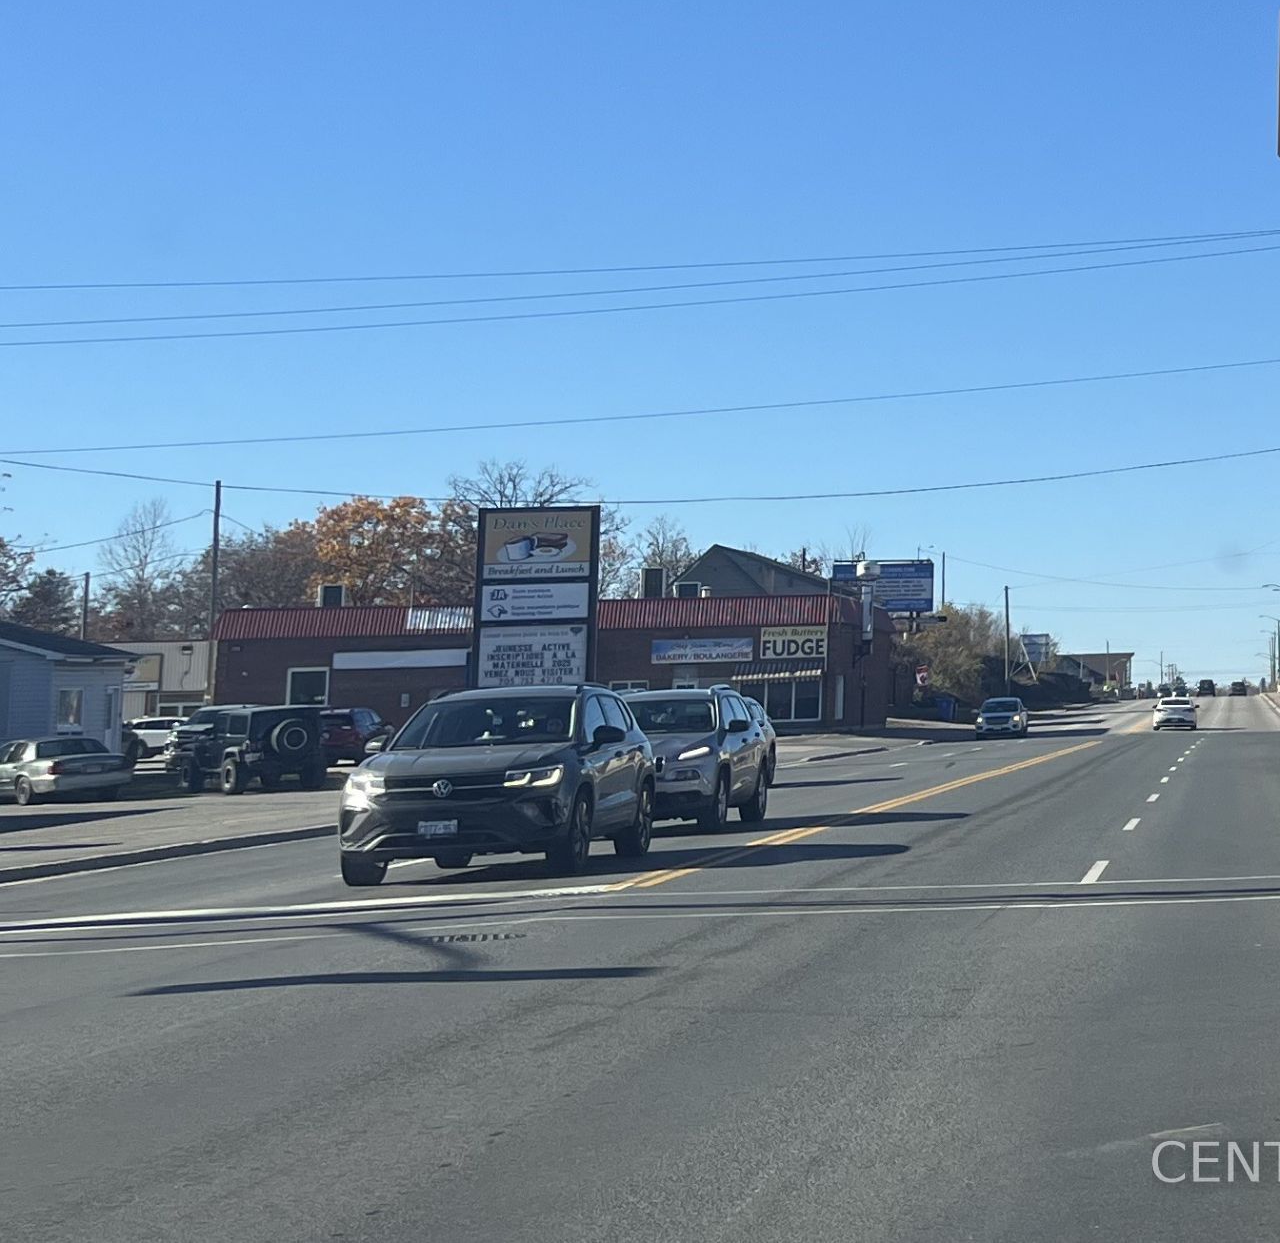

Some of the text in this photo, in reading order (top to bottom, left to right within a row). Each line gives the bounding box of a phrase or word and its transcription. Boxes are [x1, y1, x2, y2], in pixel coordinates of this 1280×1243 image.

[544, 515, 585, 528] Place
[487, 564, 585, 576] Breakfast and Lunch
[762, 628, 824, 638] Fresh Buttery
[493, 643, 570, 653] JEUNESSE ACTIVE
[762, 638, 825, 657] FUDGE
[487, 652, 544, 661] INSCRIPTIONS
[492, 659, 571, 669] MATERNELLE 2025
[483, 670, 509, 678] VENEZ
[514, 669, 535, 677] NOUS
[541, 667, 573, 676] VISITER
